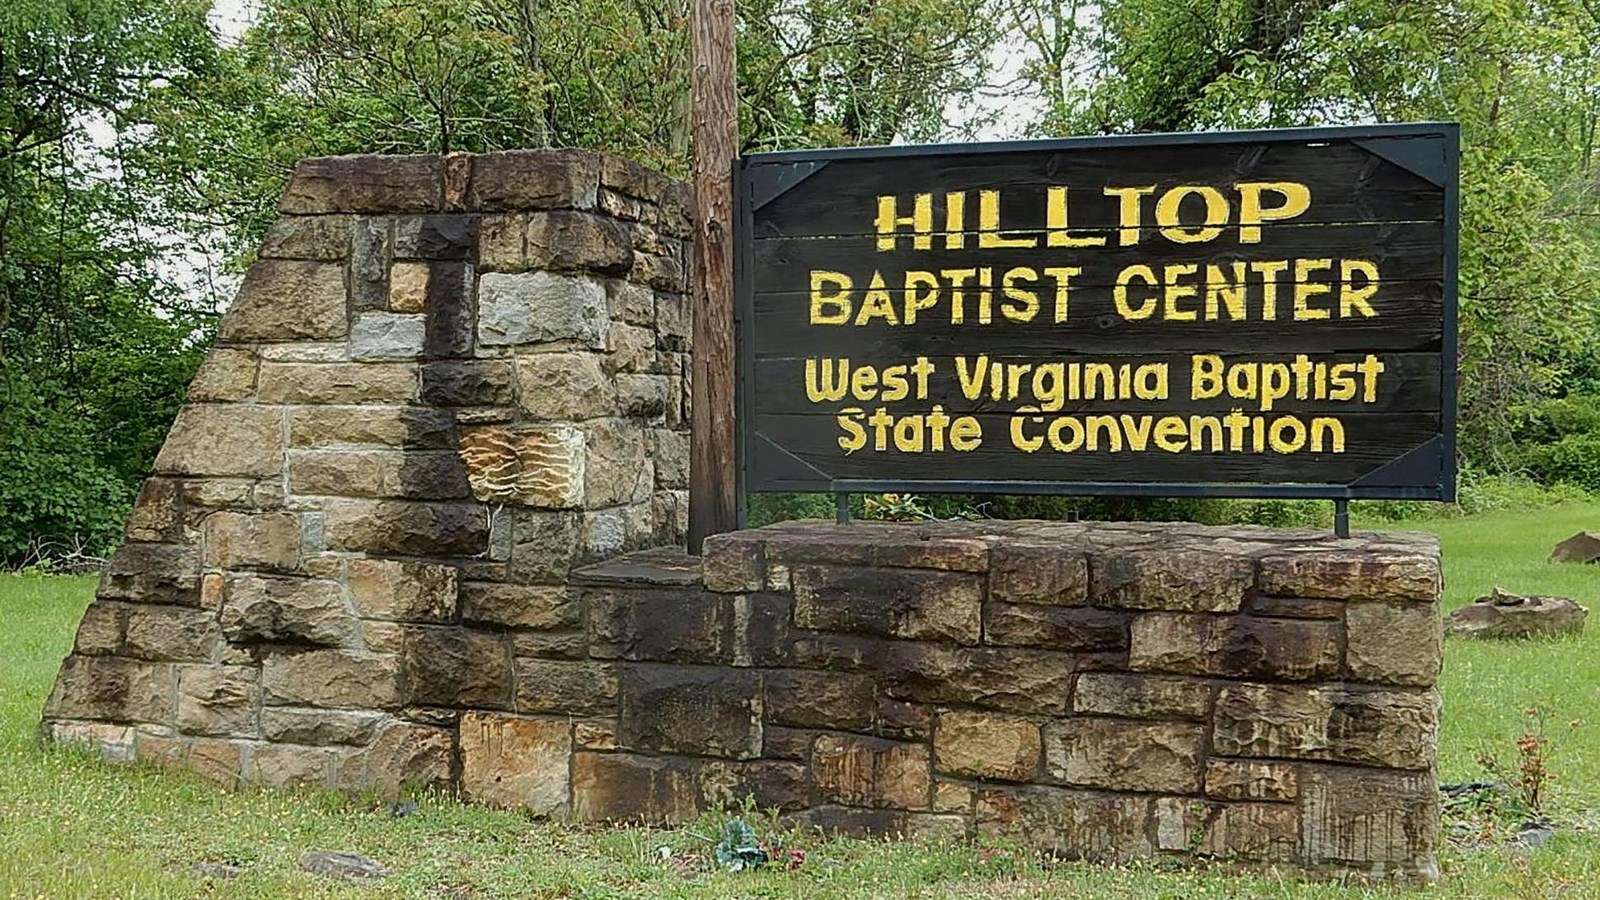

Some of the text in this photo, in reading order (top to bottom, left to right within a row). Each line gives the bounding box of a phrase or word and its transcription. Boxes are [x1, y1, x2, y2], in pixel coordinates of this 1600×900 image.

[874, 181, 1312, 251] HILLTOP
[808, 258, 1381, 327] BAPTIST CENTER
[804, 353, 1385, 412] West Virginia Baptist
[836, 404, 1346, 455] State Convention
